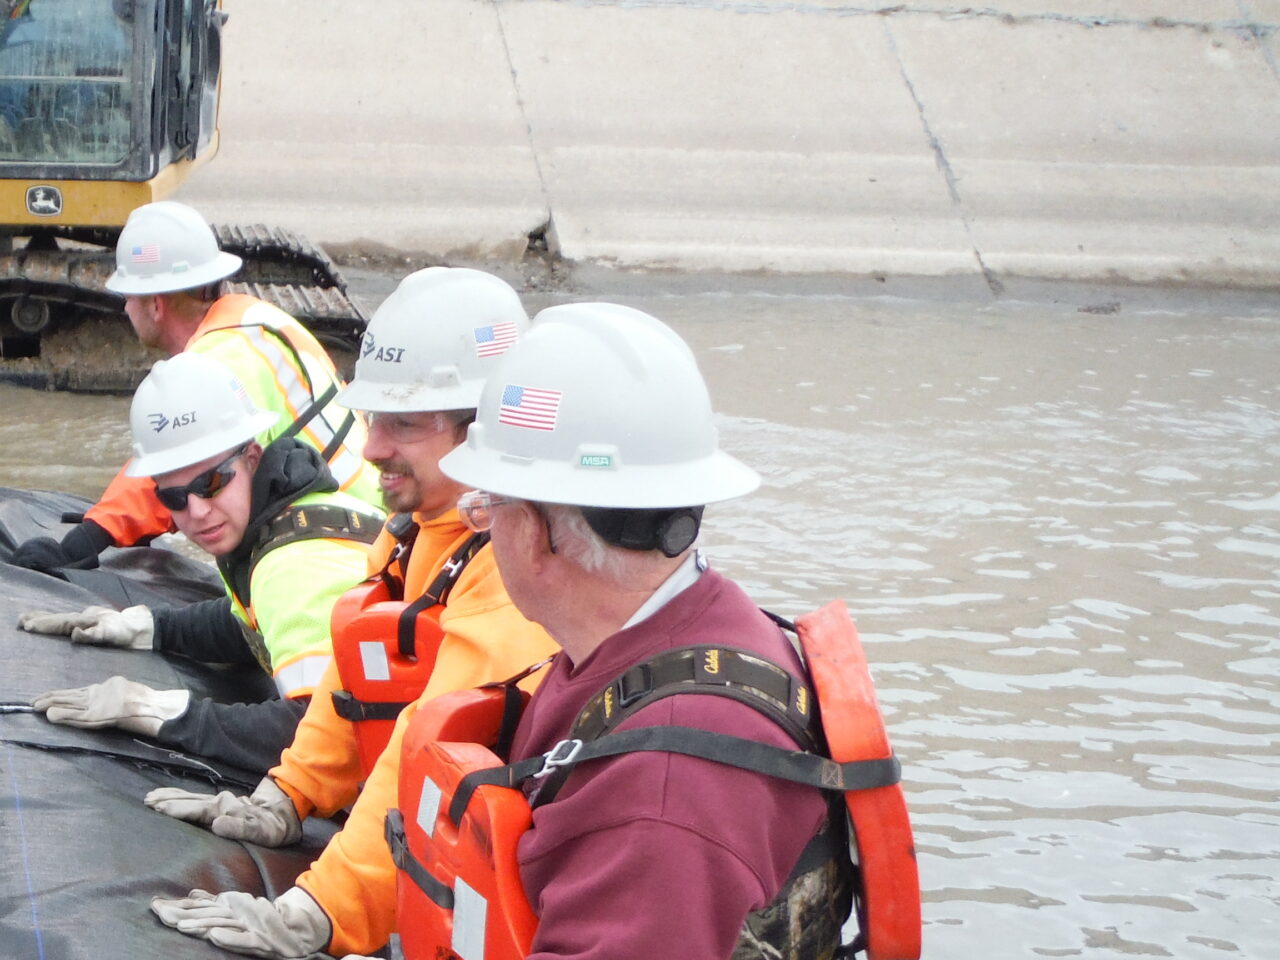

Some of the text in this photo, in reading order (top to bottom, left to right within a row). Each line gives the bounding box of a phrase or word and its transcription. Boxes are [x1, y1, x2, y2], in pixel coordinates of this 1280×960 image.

[374, 346, 406, 363] ASI
[172, 411, 197, 430] ASI
[582, 456, 609, 466] MSA
